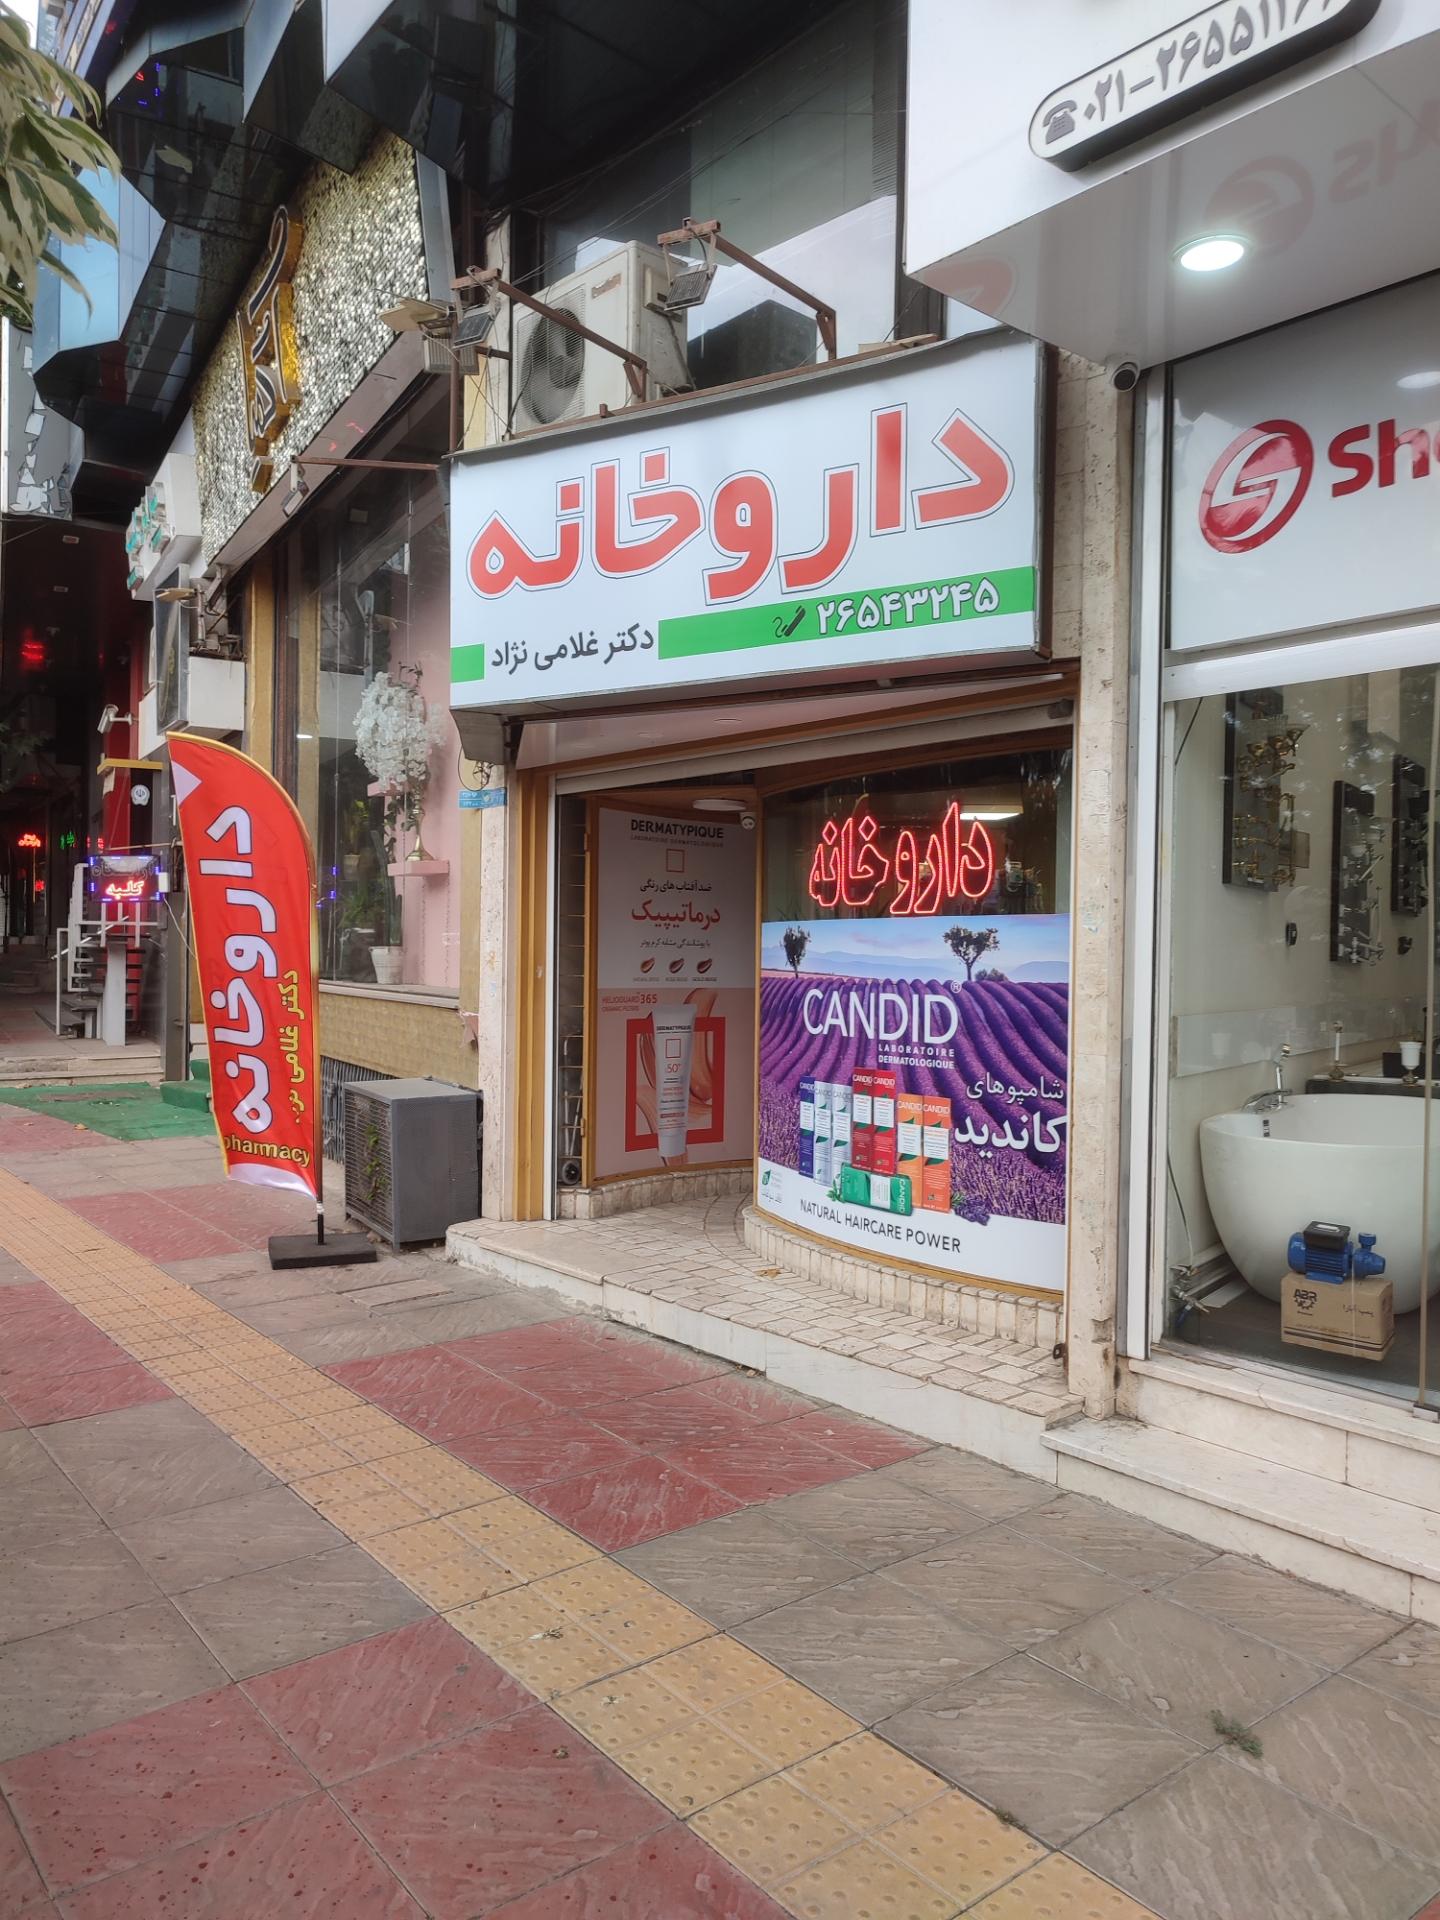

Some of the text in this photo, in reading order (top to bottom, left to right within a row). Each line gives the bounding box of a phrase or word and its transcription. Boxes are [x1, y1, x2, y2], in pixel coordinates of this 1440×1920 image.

[1328, 418, 1440, 499] Sh
[467, 402, 1016, 606] داروخانه
[816, 576, 1000, 635] ۲۶۵۴۳۲۴۵
[490, 623, 655, 674] دکتر غلامی نژاد
[631, 819, 724, 839] DERMATYPIQUE
[808, 801, 993, 915] داروخانه
[631, 900, 721, 930] درماتیپیک
[199, 805, 278, 1135] داروخانه
[278, 970, 305, 1020] دکتر
[640, 993, 657, 1004] 365
[803, 988, 960, 1044] CANDID
[279, 1025, 305, 1083] غلامی
[878, 1043, 955, 1057] LABORATOIRE
[878, 1055, 955, 1069] DERMATOLOGIQUE
[966, 1071, 1064, 1105] شامپوهای
[954, 1110, 1068, 1159] کاندید
[800, 1199, 961, 1253] NATURAL HAIRCARE POWER
